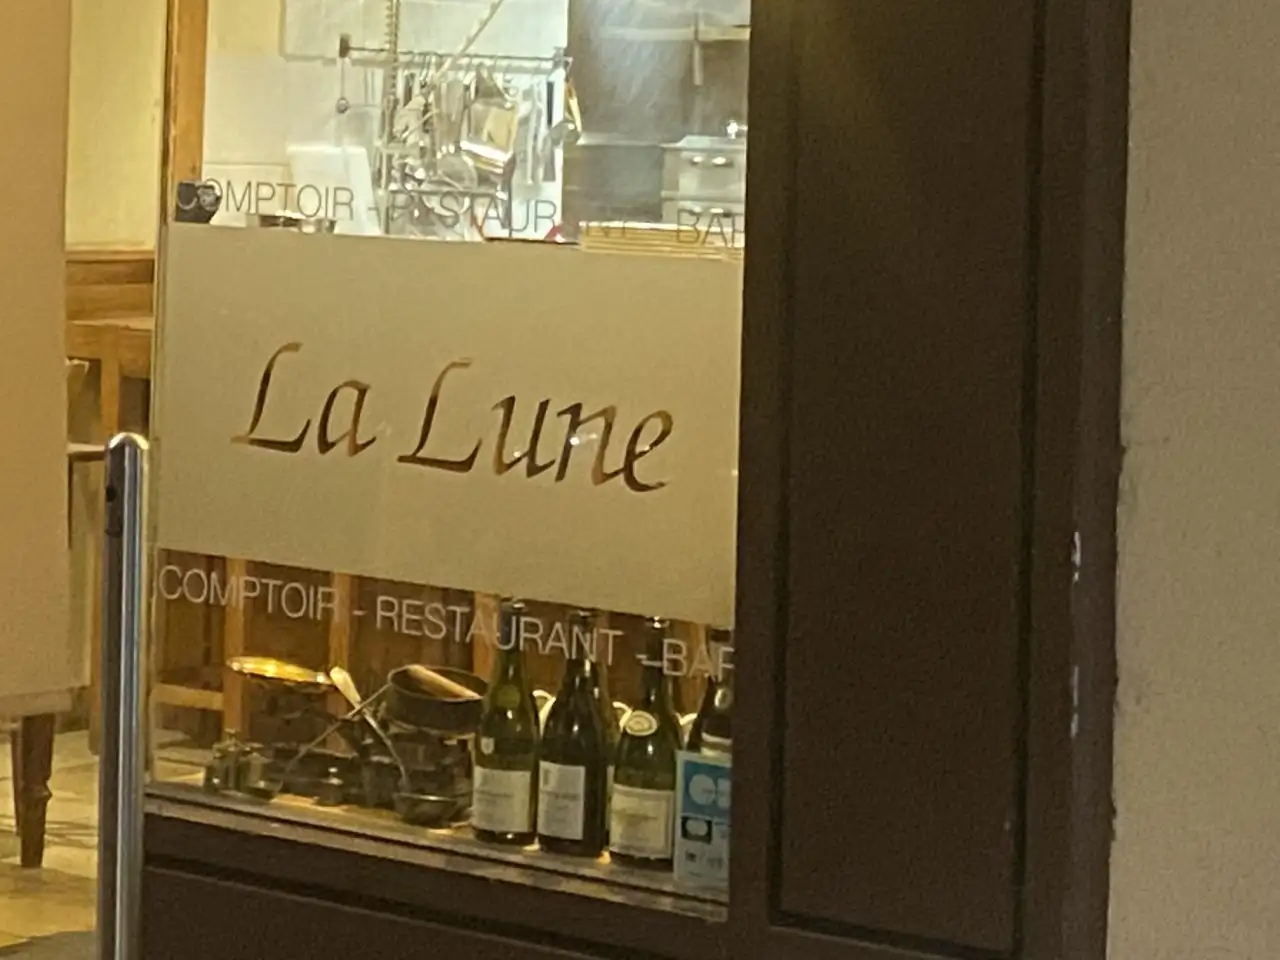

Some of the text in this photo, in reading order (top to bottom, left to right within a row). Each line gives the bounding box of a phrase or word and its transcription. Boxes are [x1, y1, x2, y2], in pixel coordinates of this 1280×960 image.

[230, 342, 674, 492] La Lune
[159, 565, 339, 622] COMPTOIR
[375, 595, 624, 666] RESTAURANT
